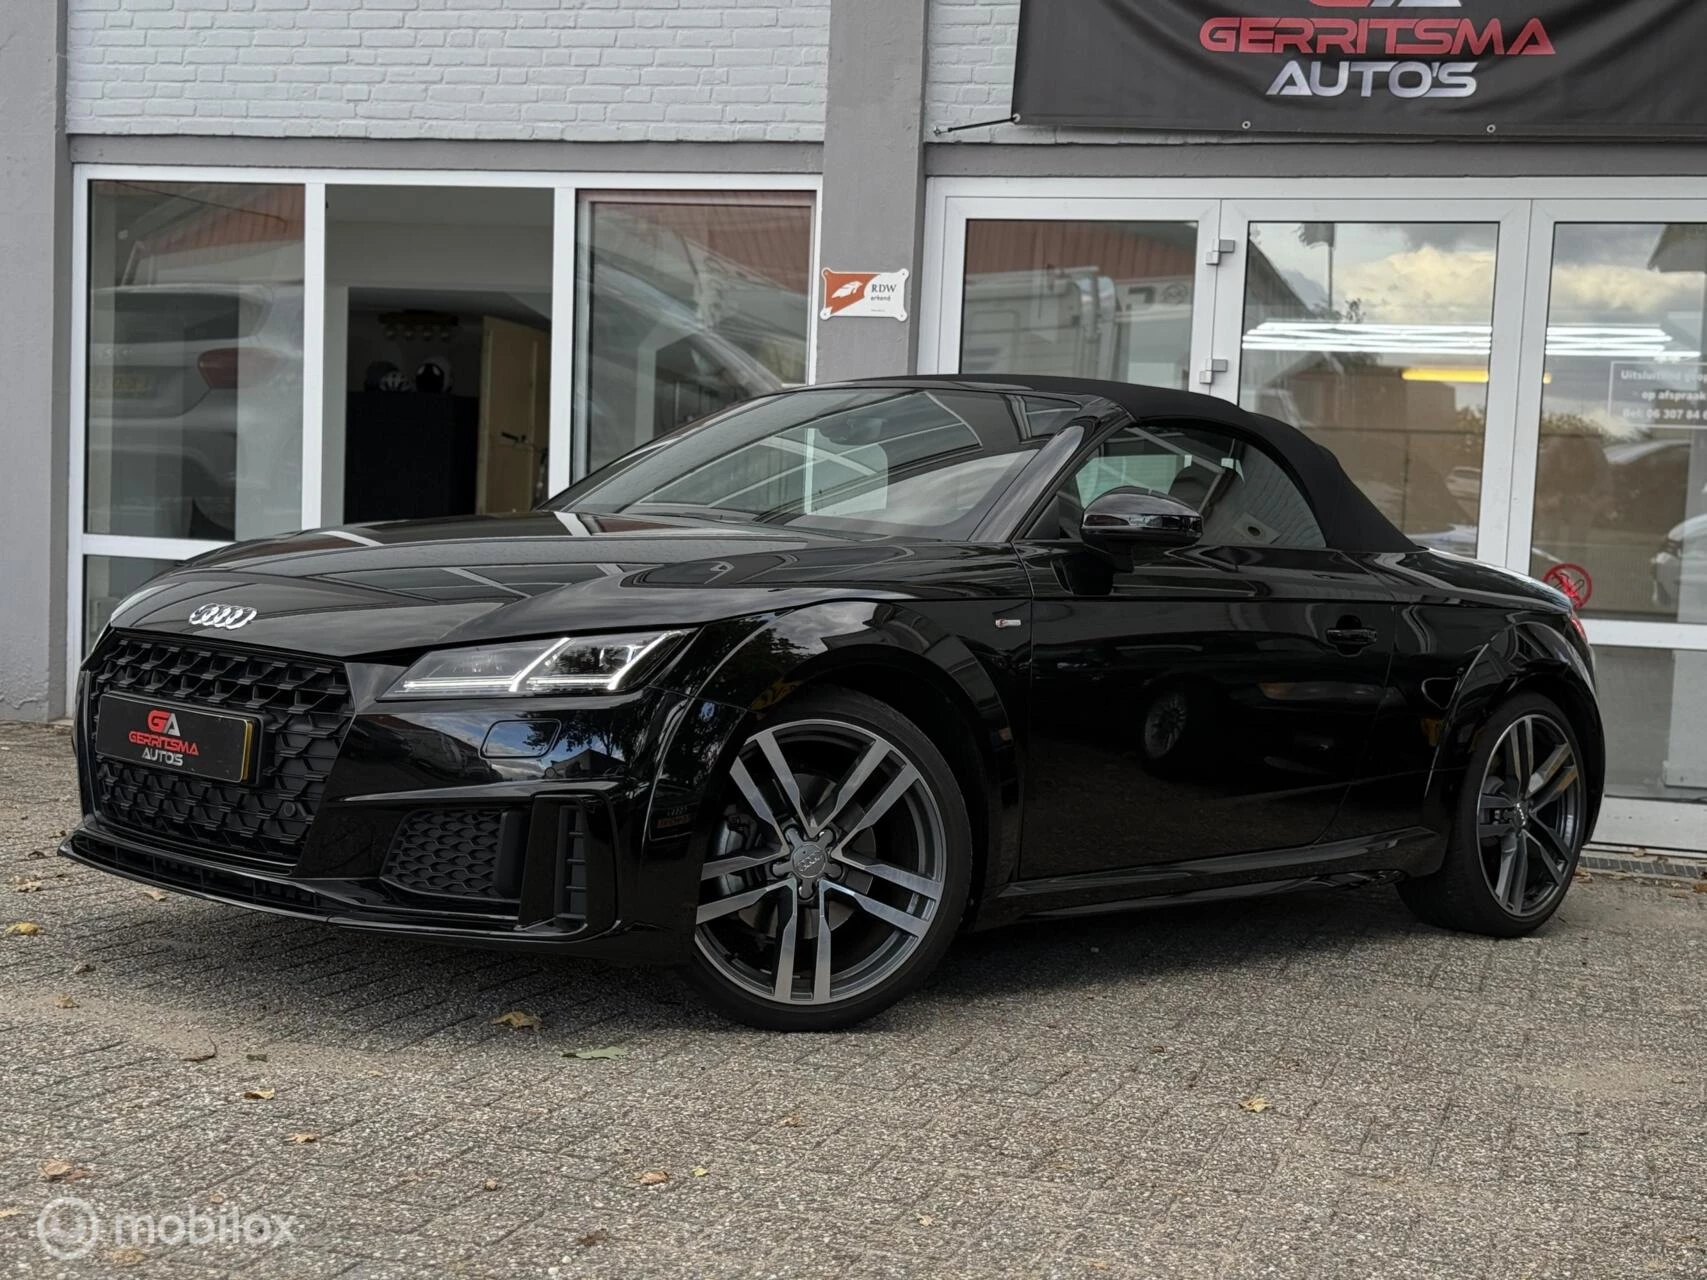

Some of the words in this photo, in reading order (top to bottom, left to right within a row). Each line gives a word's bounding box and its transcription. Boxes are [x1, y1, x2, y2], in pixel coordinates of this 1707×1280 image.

[1199, 17, 1556, 56] GERRITSMA
[1266, 60, 1478, 99] AUTO'S
[871, 283, 897, 293] RDW
[1641, 392, 1655, 402] op
[1646, 408, 1660, 418] 06
[128, 730, 199, 756] GERRITSMA
